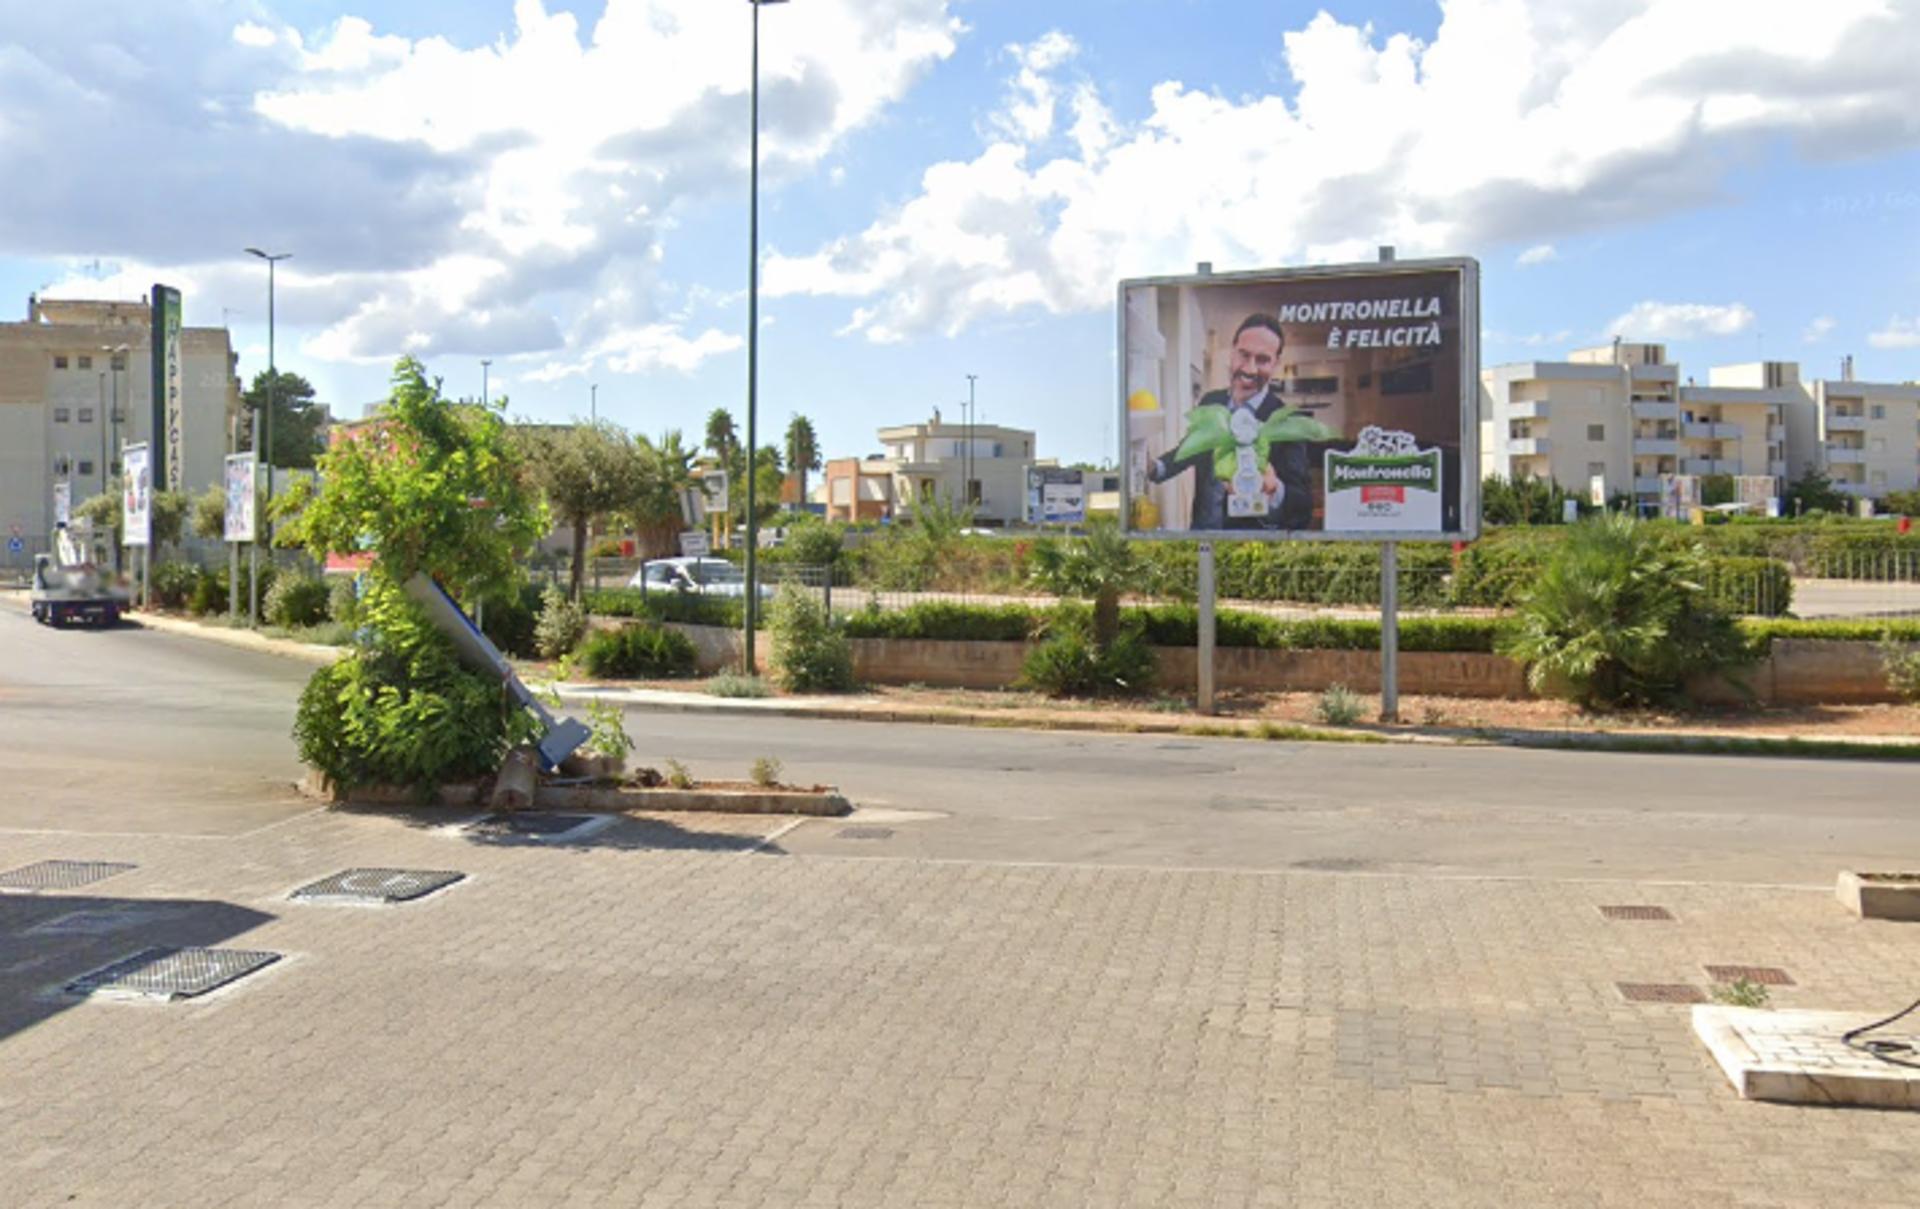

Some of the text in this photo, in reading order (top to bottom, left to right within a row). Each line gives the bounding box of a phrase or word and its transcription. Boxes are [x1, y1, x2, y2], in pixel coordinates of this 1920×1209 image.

[1279, 297, 1441, 323] MONTRONELLA
[1327, 321, 1441, 349] È FELICITÀ
[1334, 464, 1432, 480] Montronella
